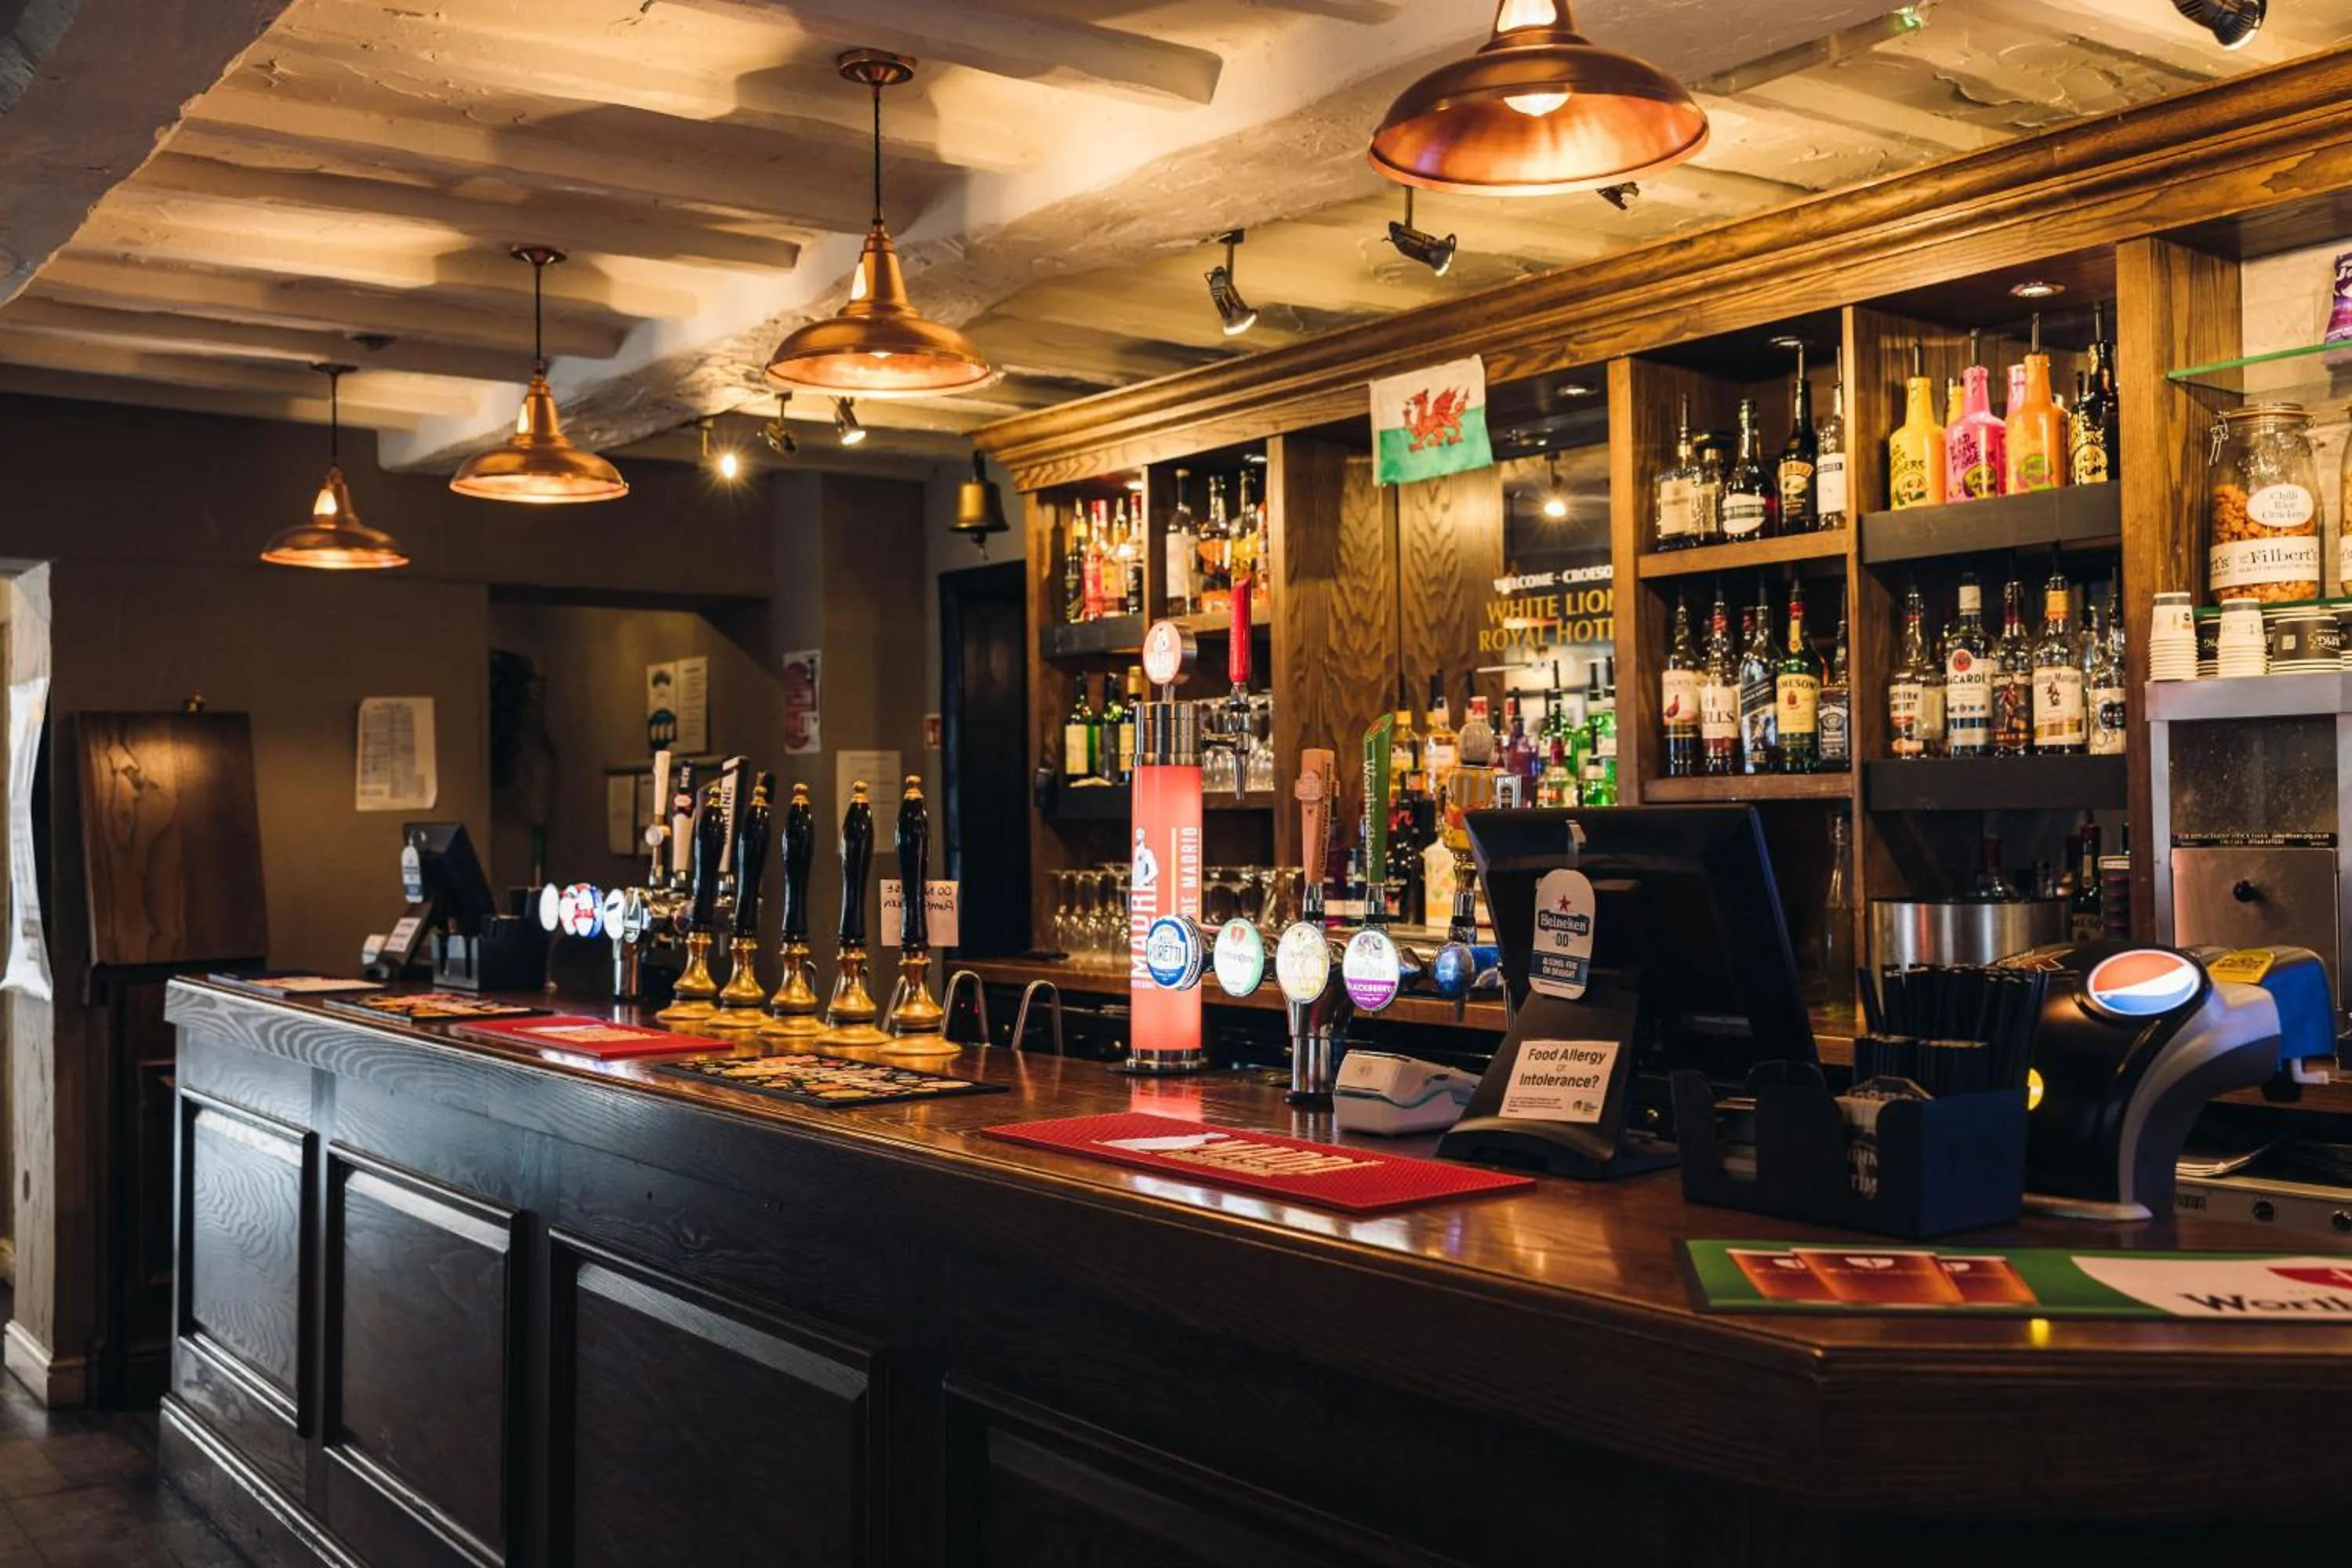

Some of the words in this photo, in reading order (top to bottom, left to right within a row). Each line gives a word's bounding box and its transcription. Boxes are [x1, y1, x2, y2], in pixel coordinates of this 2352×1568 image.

[1486, 594, 1559, 624] WHITE
[1479, 625, 1548, 652] ROYAL
[1181, 827, 1199, 888] MADRID
[1541, 913, 1586, 931] Heineken
[1528, 1048, 1559, 1061] Food
[1559, 1048, 1606, 1065] Allergy
[1556, 1064, 1567, 1073] or
[1519, 1072, 1600, 1089] Intolerance?
